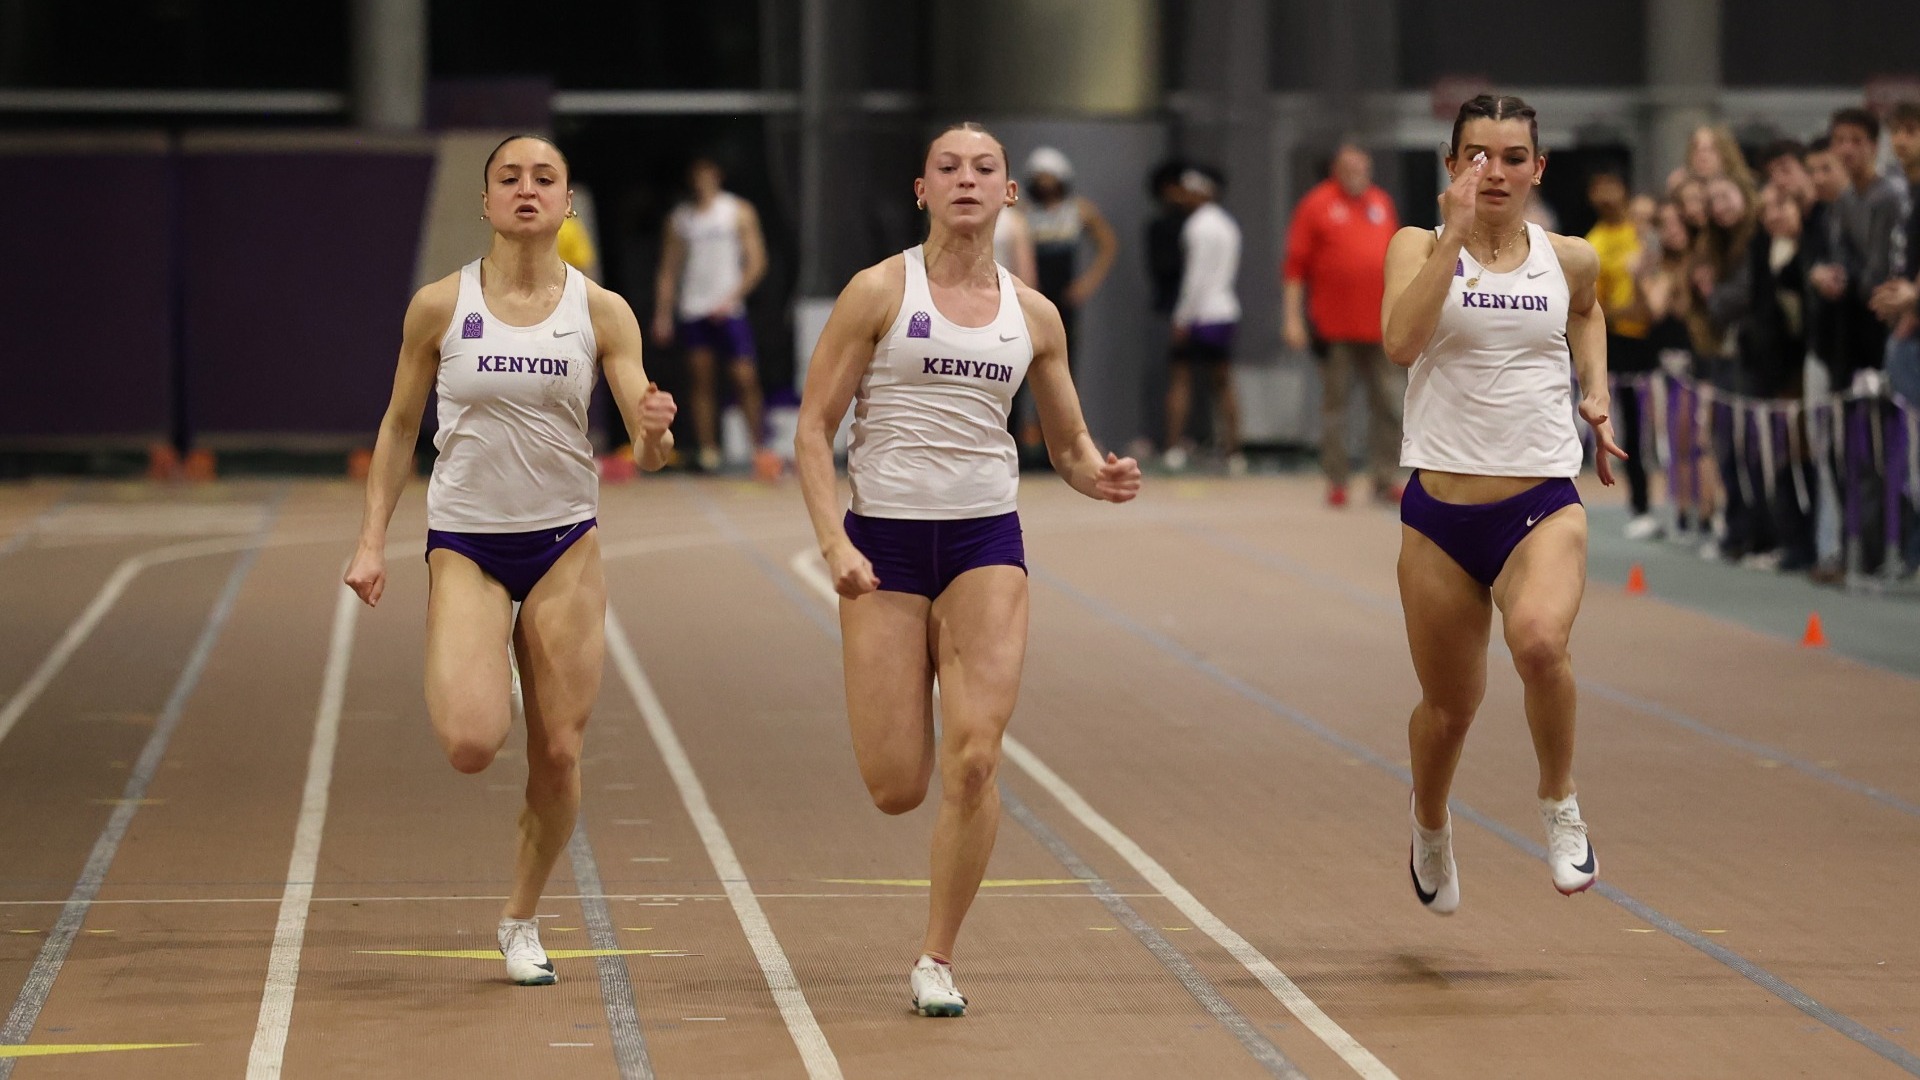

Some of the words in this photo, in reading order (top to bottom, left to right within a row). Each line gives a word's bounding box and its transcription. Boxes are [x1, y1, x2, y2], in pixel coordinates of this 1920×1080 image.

[1462, 291, 1548, 312] KENYON
[477, 355, 568, 377] KENYON
[922, 357, 1013, 383] KENYON
